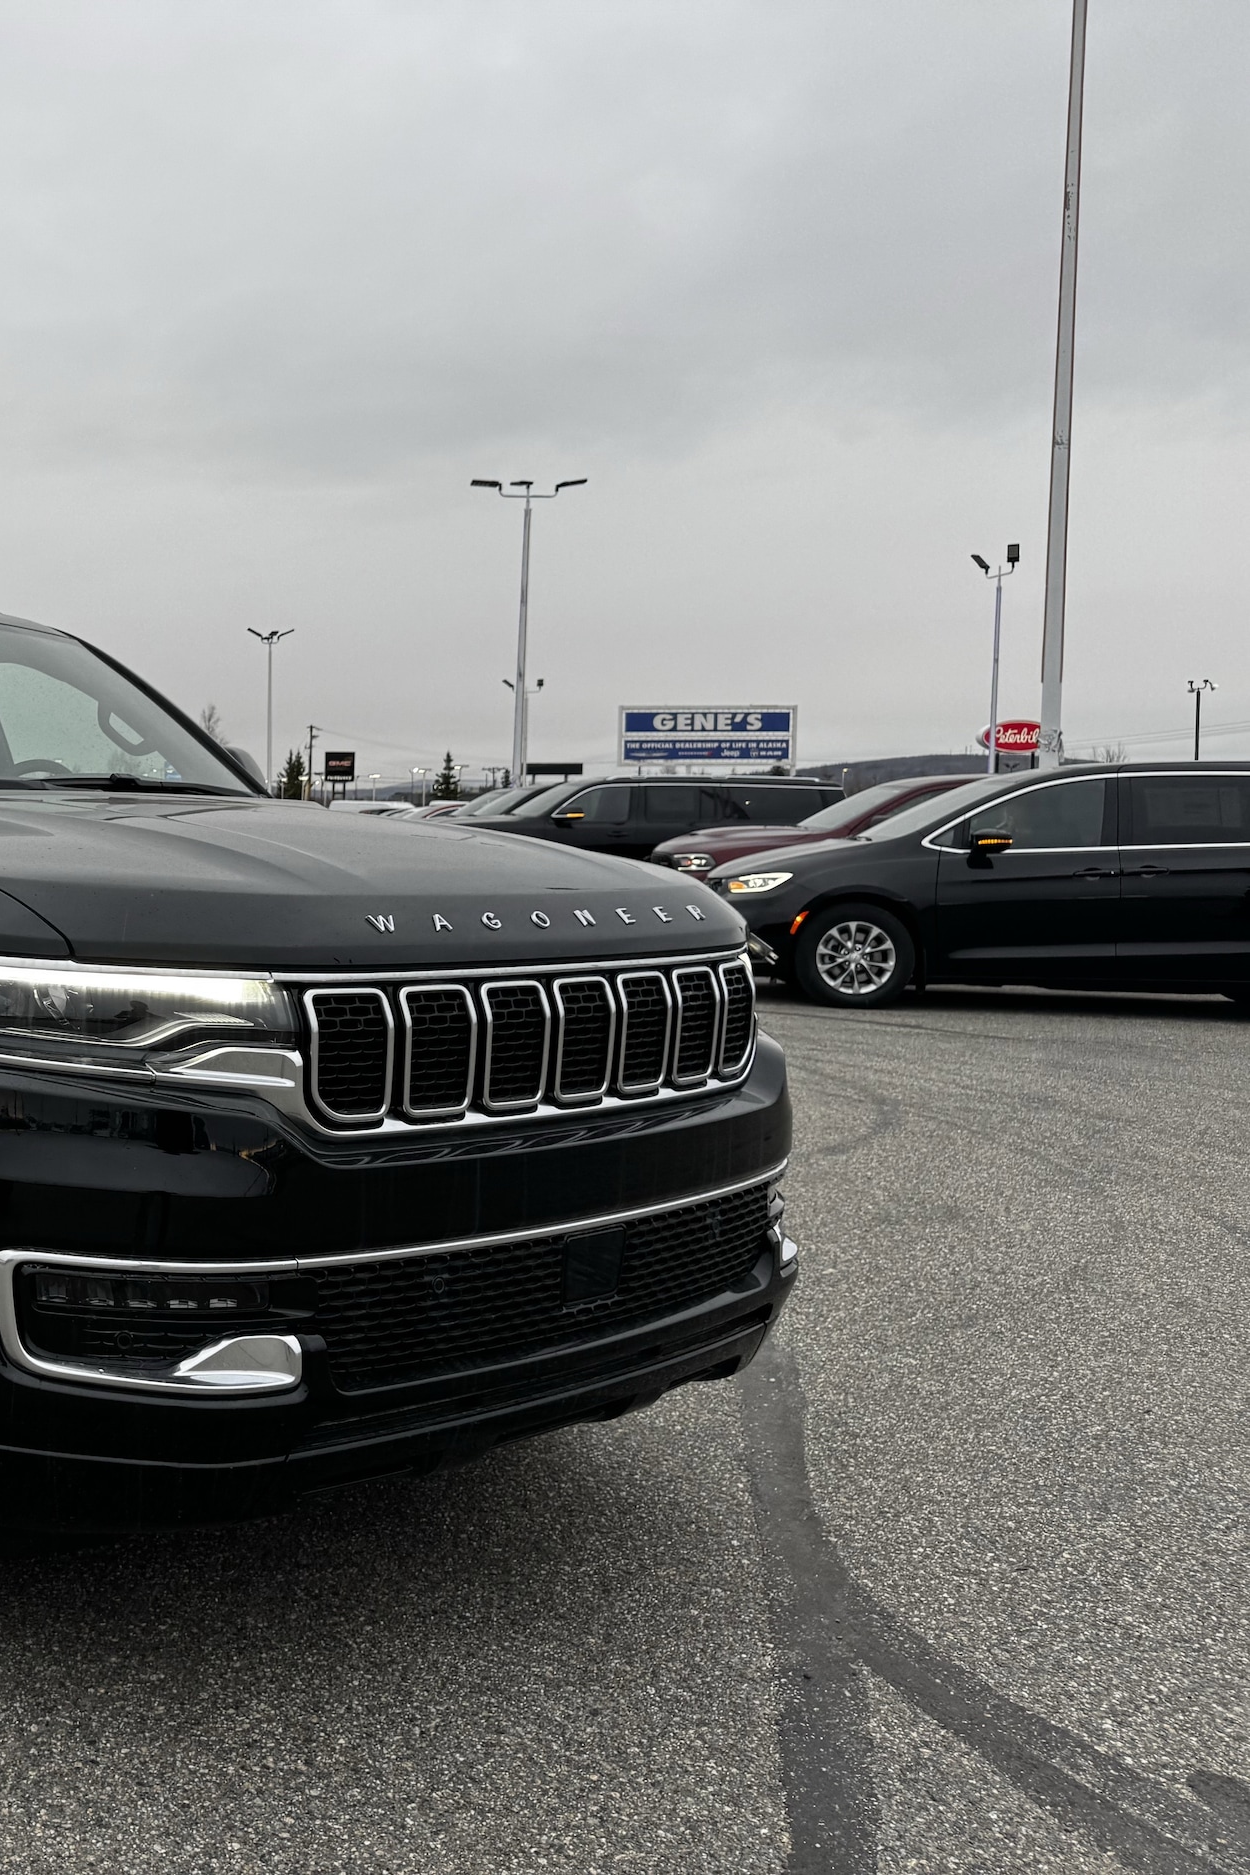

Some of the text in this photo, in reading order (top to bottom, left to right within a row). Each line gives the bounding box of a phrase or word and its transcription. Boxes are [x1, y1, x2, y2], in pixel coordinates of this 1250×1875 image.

[652, 713, 762, 731] GENE'S
[995, 726, 1039, 744] Peterbil
[720, 749, 740, 758] Jeep
[365, 904, 707, 933] WAGONEER
